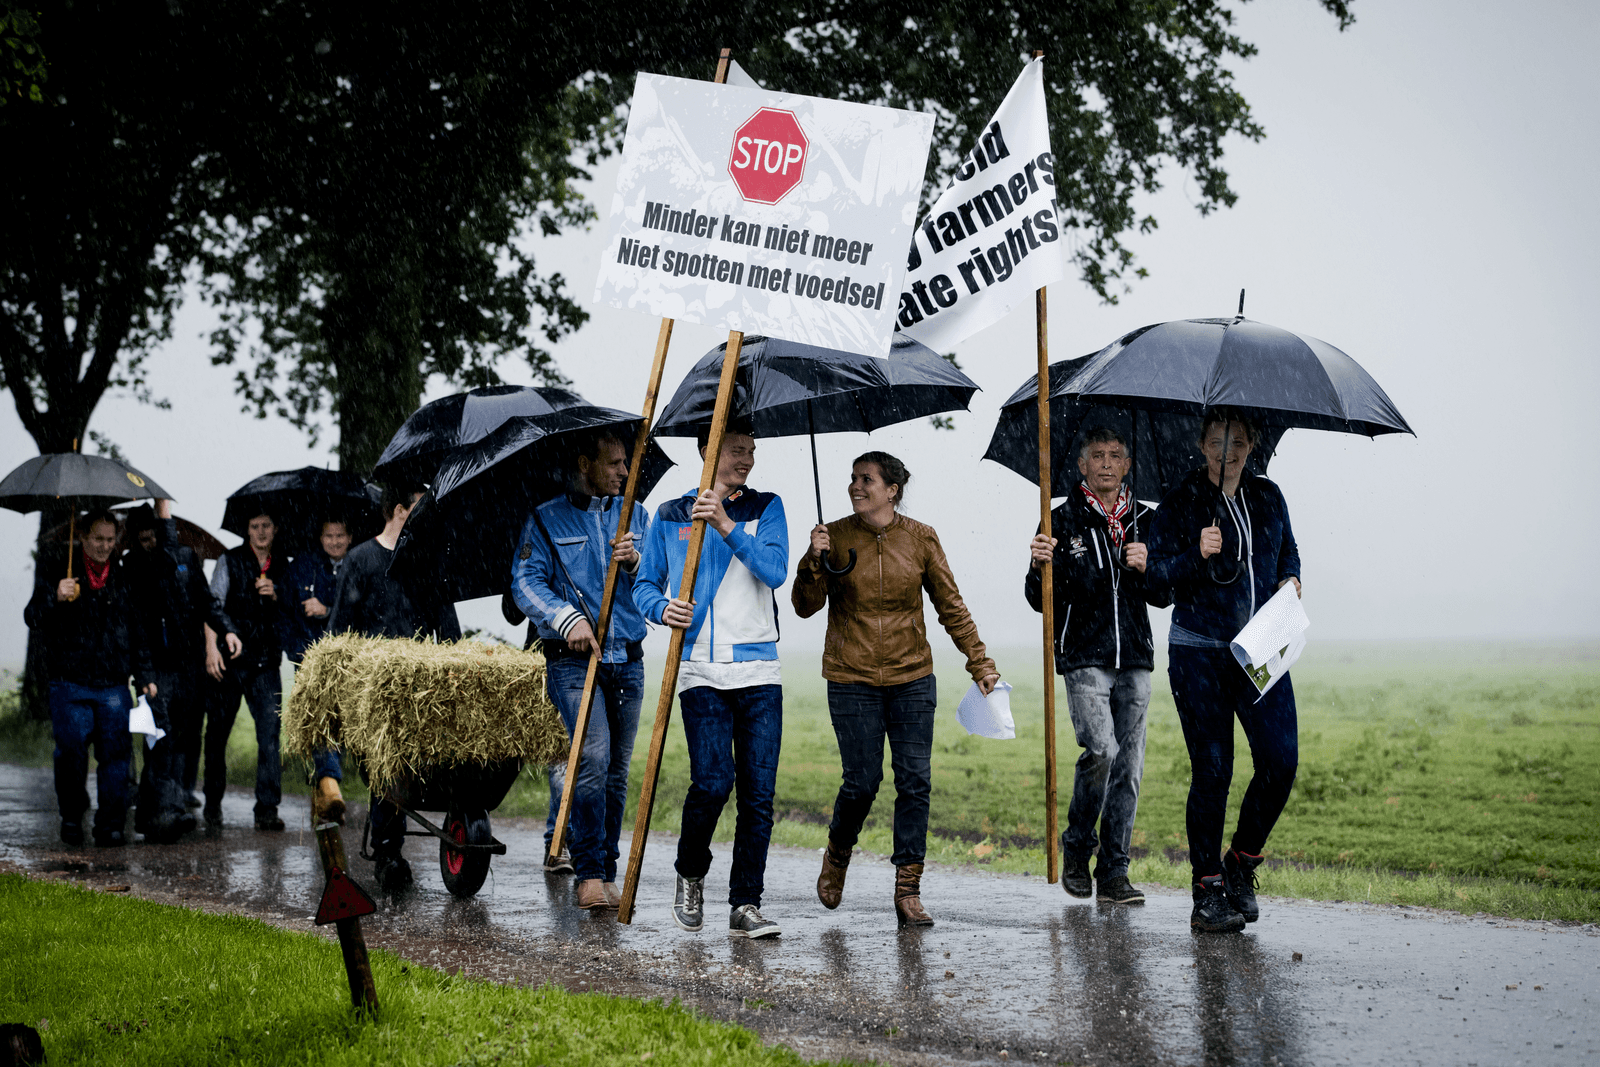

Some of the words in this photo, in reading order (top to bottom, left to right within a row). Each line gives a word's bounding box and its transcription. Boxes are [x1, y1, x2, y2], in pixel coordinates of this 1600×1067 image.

[733, 136, 803, 175] STOP
[642, 201, 718, 239] Minder
[720, 214, 762, 247] kan
[764, 223, 809, 256] niet
[811, 234, 873, 266] meer
[922, 151, 1054, 254] farmers
[617, 237, 660, 270] Niet
[662, 249, 744, 285] spotten
[747, 264, 792, 294] met
[795, 273, 885, 311] voedsel
[894, 273, 958, 333] ate
